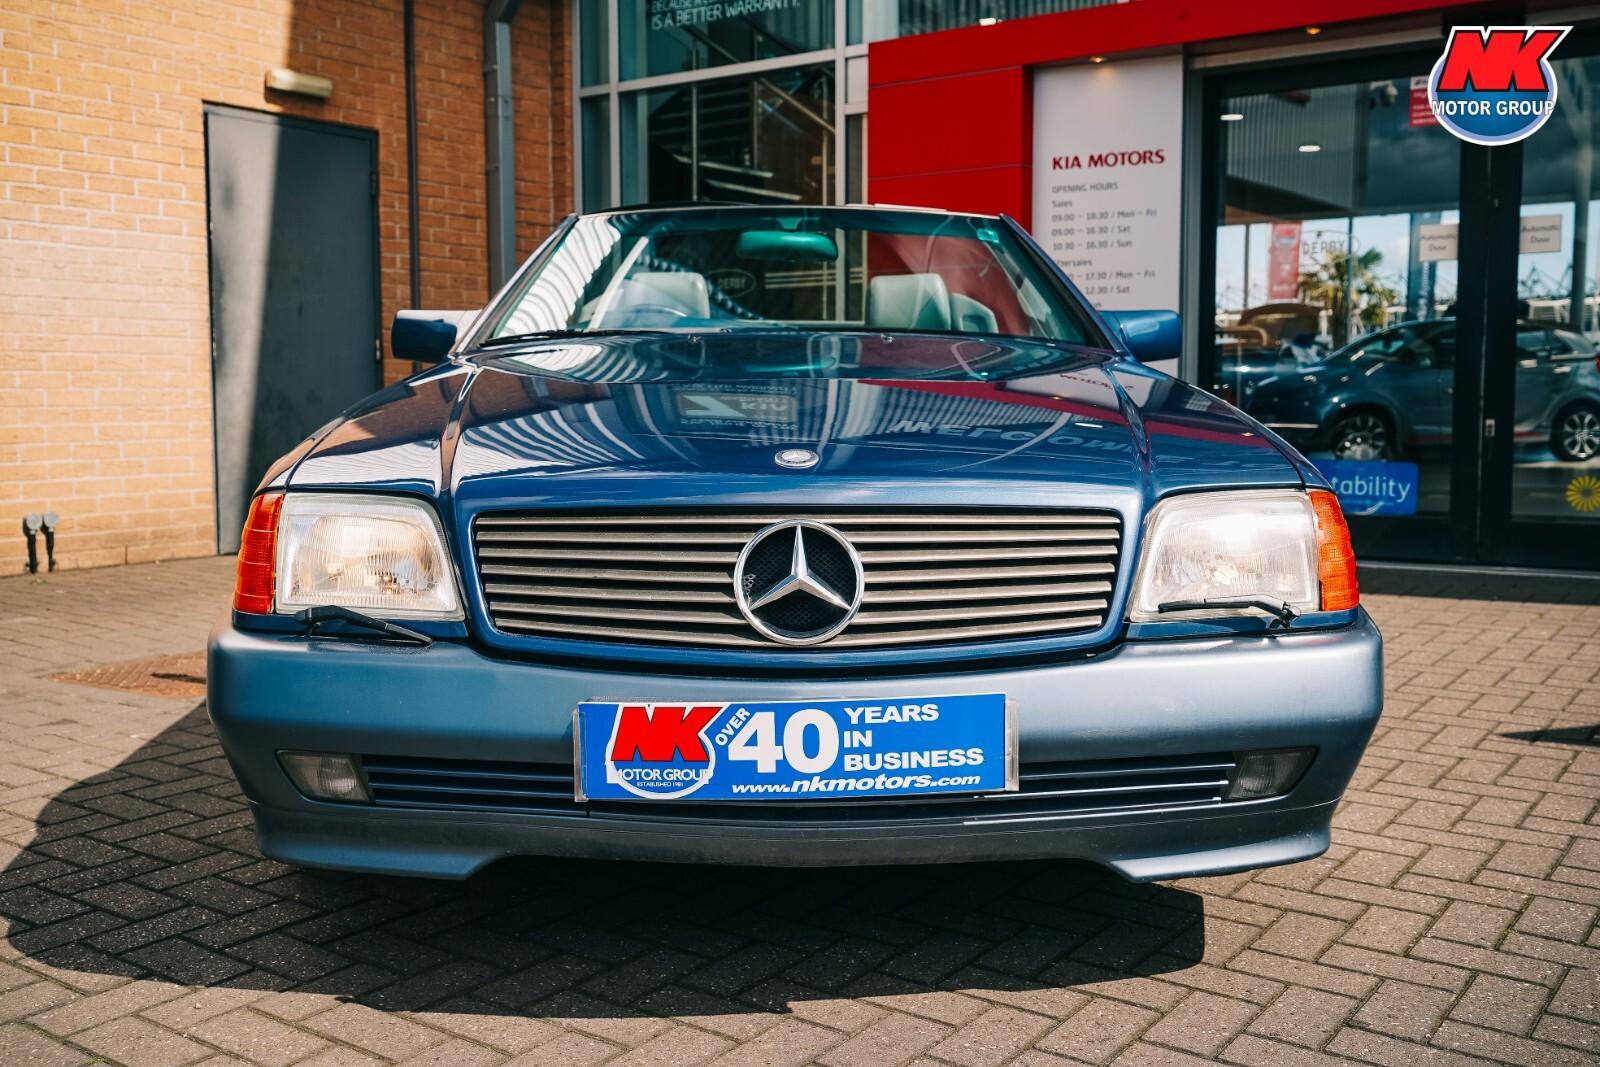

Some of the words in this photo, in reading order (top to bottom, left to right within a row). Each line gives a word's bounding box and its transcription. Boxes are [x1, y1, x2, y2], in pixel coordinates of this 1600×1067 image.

[651, 15, 662, 30] IS
[664, 13, 674, 27] A
[676, 3, 723, 26] BETTER
[1052, 155, 1082, 170] KIA
[1088, 149, 1165, 168] MOTORS
[1052, 183, 1087, 193] OPENING
[1090, 182, 1118, 191] HOURS
[1052, 200, 1073, 208] Sales
[1117, 225, 1131, 233] Sat
[1117, 240, 1132, 248] Sun
[1056, 258, 1092, 267] ftersales
[1115, 271, 1133, 279] Mon
[1116, 285, 1130, 293] Sat
[1330, 475, 1411, 503] tability
[843, 703, 940, 725] YEARS
[611, 706, 723, 762] NK
[714, 707, 751, 746] OVER
[728, 709, 839, 774] 40
[843, 730, 872, 748] IN
[843, 748, 984, 772] BUSINESS
[731, 774, 981, 795] www.nkmotors.com
